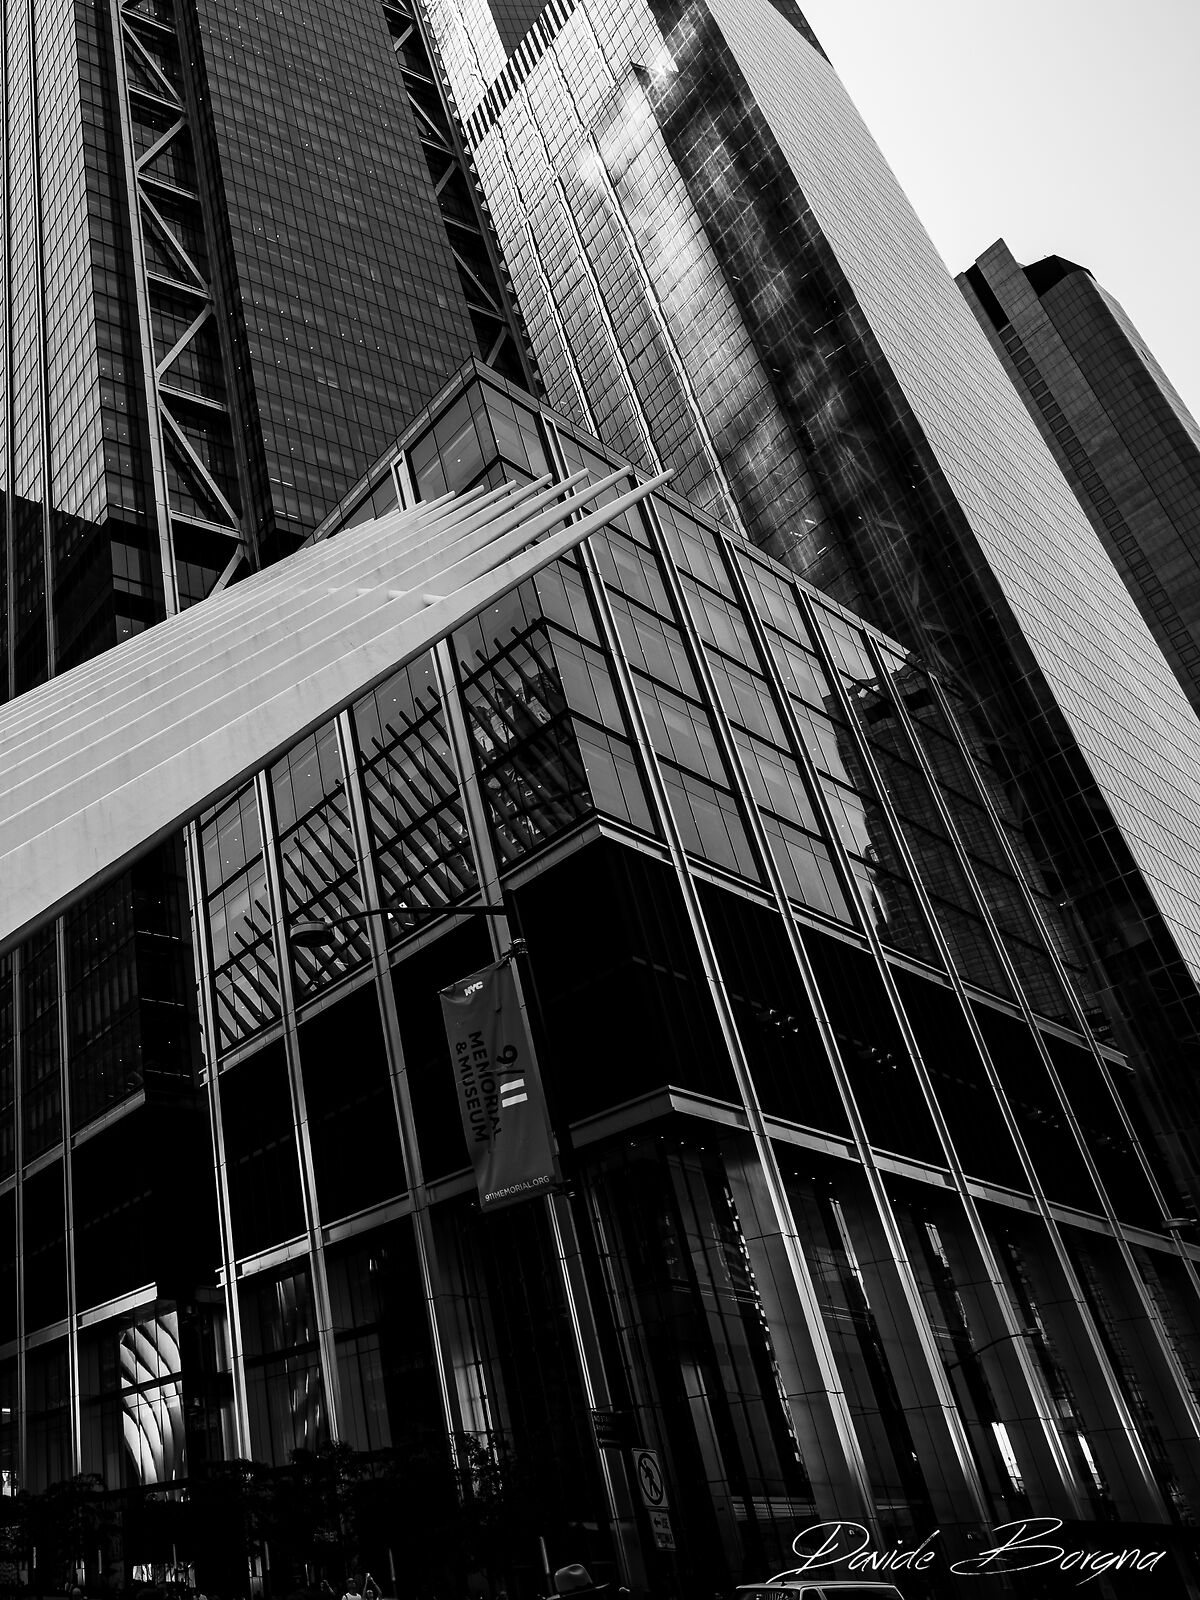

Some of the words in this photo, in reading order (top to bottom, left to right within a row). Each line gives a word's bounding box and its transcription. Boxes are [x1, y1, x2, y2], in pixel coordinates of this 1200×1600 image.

[463, 980, 484, 996] NYC
[455, 1041, 467, 1054] &
[457, 1055, 490, 1142] MUSEUM
[468, 1031, 502, 1142] MEMORIAL
[484, 1175, 550, 1202] 911MEMORIAL.ORG
